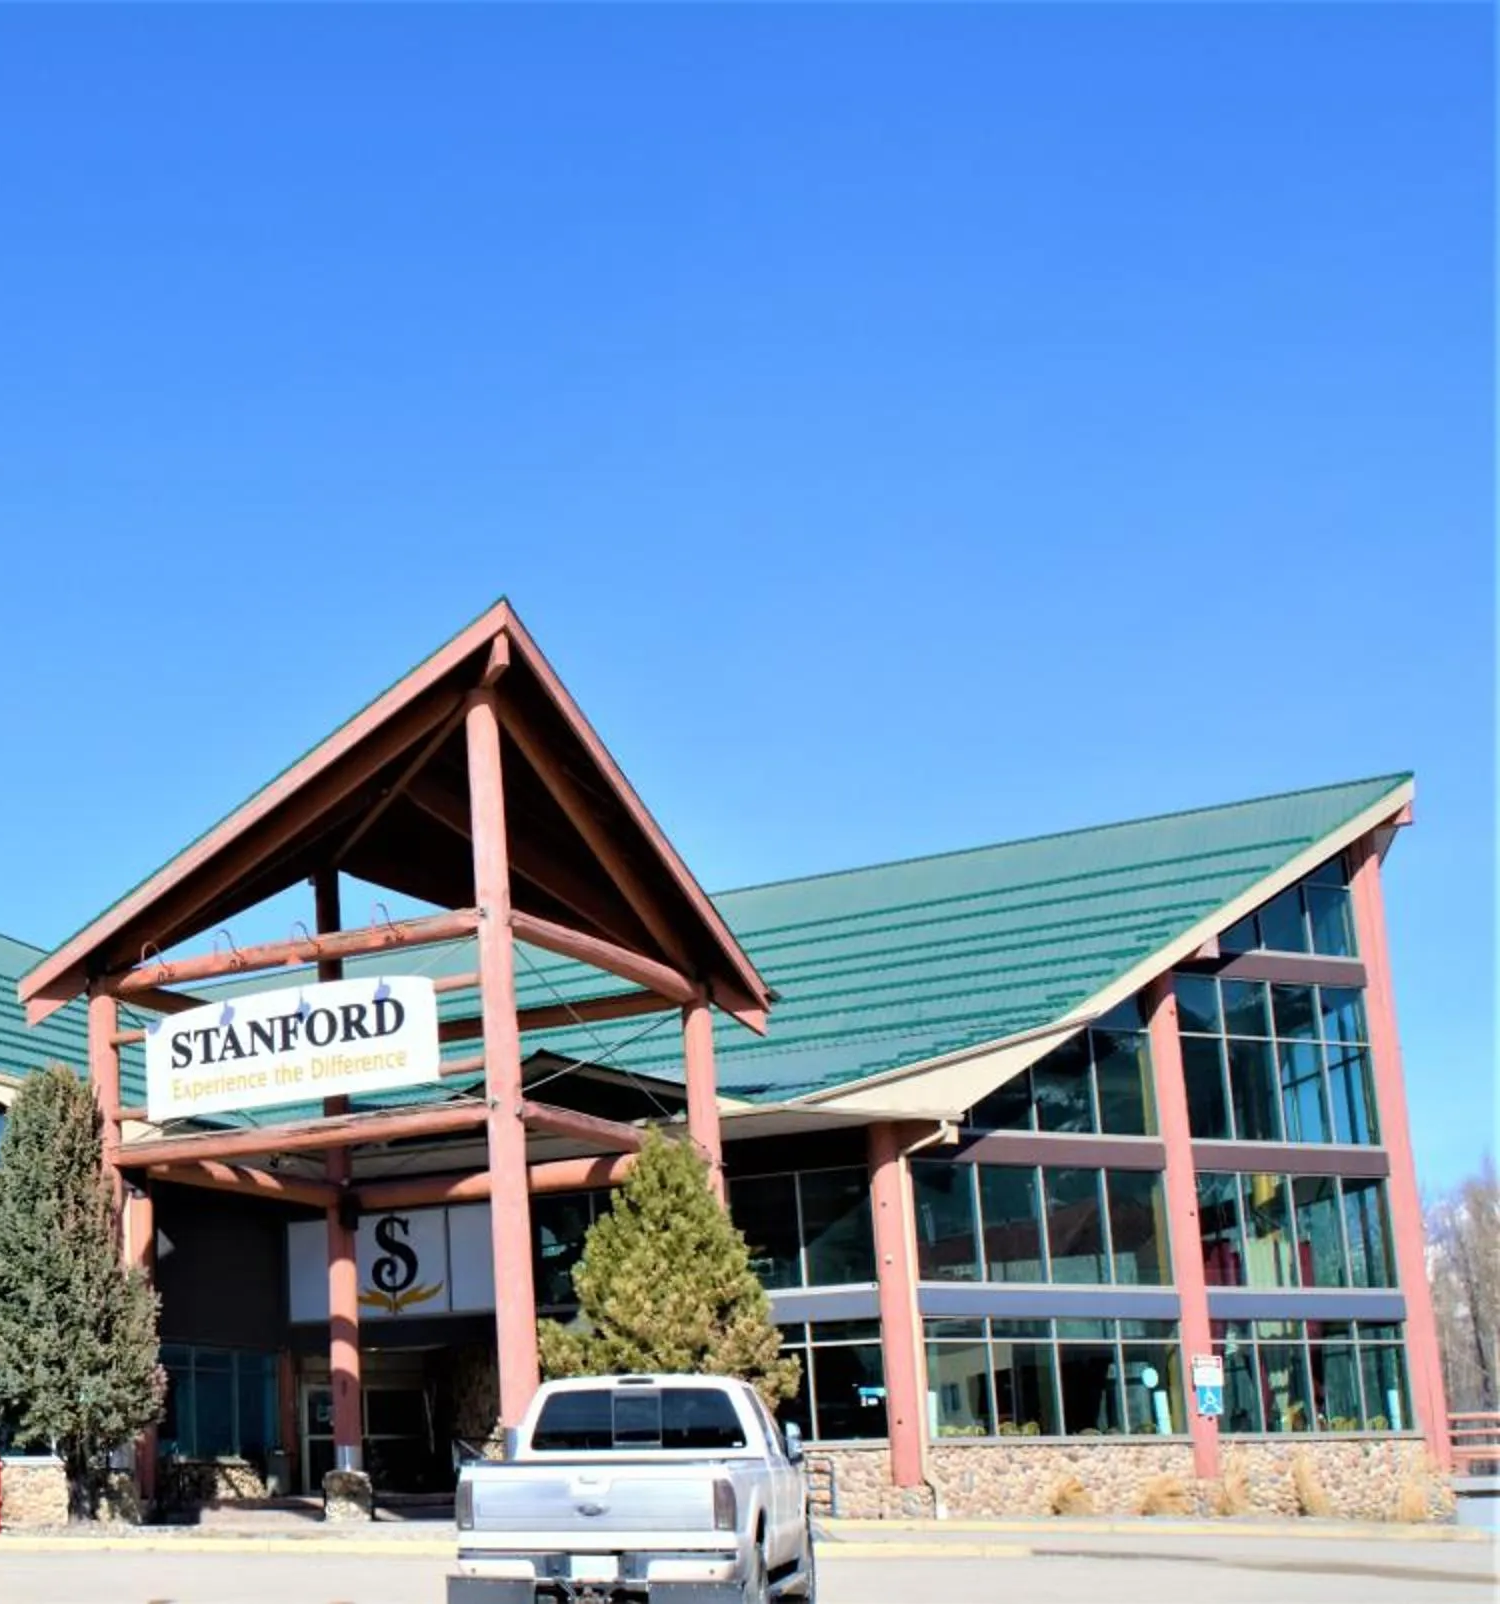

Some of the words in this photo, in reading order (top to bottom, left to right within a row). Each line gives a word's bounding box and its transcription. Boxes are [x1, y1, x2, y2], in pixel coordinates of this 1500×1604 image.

[171, 997, 406, 1070] STANFORD
[172, 1071, 268, 1102] Experience
[274, 1062, 303, 1084] the
[311, 1050, 408, 1080] Difference
[372, 1216, 419, 1293] S
